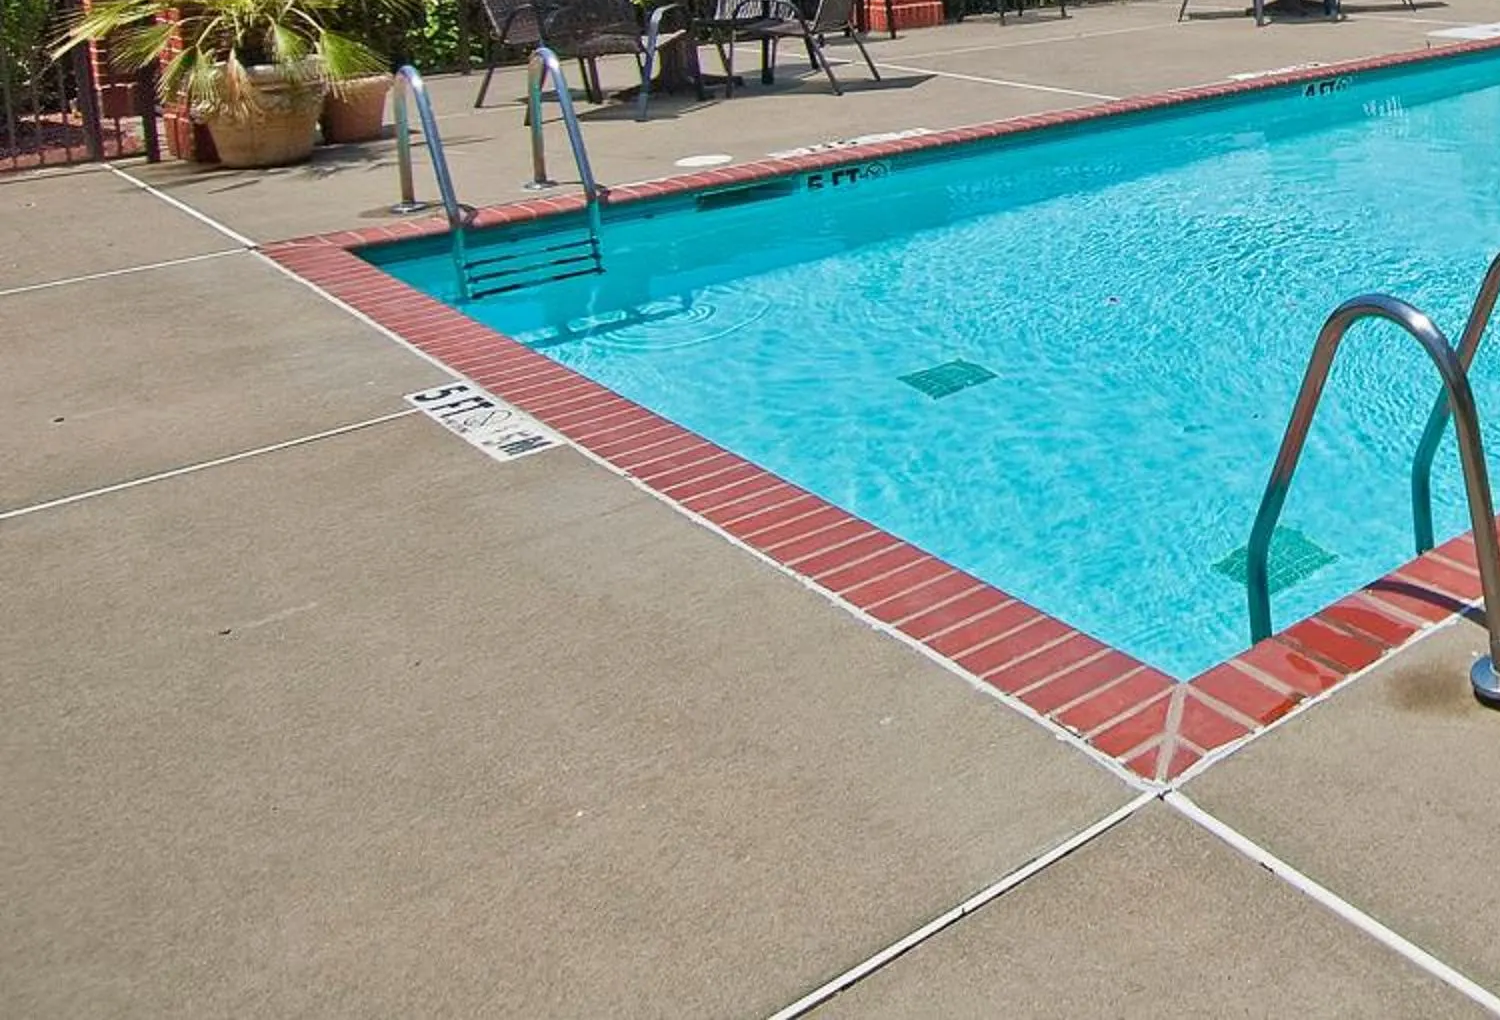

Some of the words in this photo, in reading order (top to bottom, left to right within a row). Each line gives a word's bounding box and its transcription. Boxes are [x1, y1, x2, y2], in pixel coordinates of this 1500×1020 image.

[831, 167, 861, 186] FT
[414, 385, 469, 402] 5
[430, 396, 495, 418] FT
